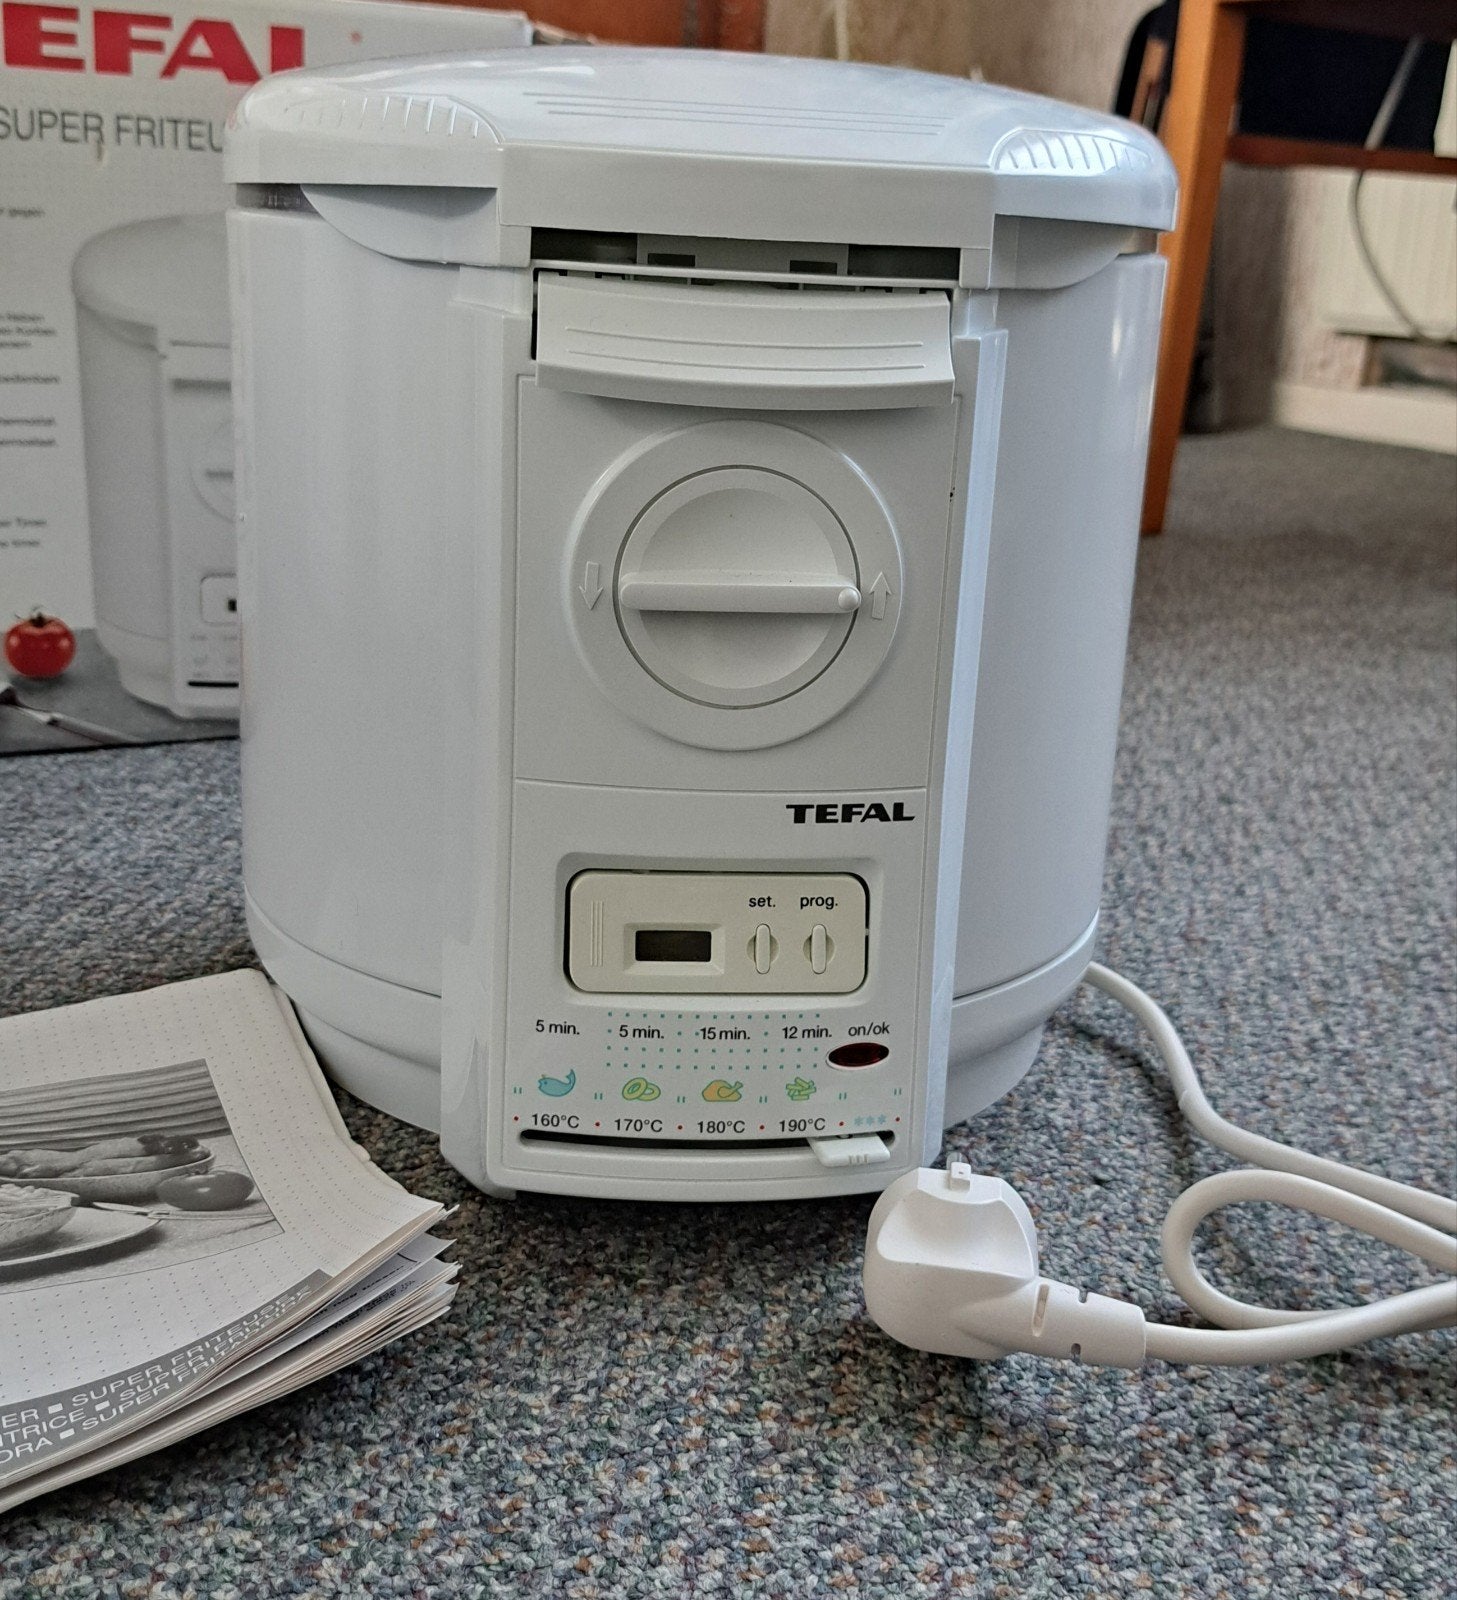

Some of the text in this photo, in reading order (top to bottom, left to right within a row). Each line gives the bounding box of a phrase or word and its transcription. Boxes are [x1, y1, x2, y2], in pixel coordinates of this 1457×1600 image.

[786, 802, 915, 824] TEFAL
[748, 895, 777, 909] set.
[800, 895, 839, 911] prog.
[535, 1020, 580, 1036] 5 min.
[619, 1025, 665, 1039] 5 min.
[700, 1027, 751, 1040] 15 min.
[782, 1025, 833, 1039] 12 min.
[848, 1021, 890, 1037] on/ok
[531, 1113, 580, 1129] 160°C
[614, 1118, 663, 1134] 170°C
[697, 1120, 746, 1135] 180°C
[779, 1117, 826, 1133] 190°C
[1, 1408, 39, 1428] ER
[72, 1364, 163, 1407] SUPER
[171, 1293, 290, 1366] FRITEUSE
[119, 1354, 205, 1401] SUPER
[82, 1382, 170, 1430] SUPER
